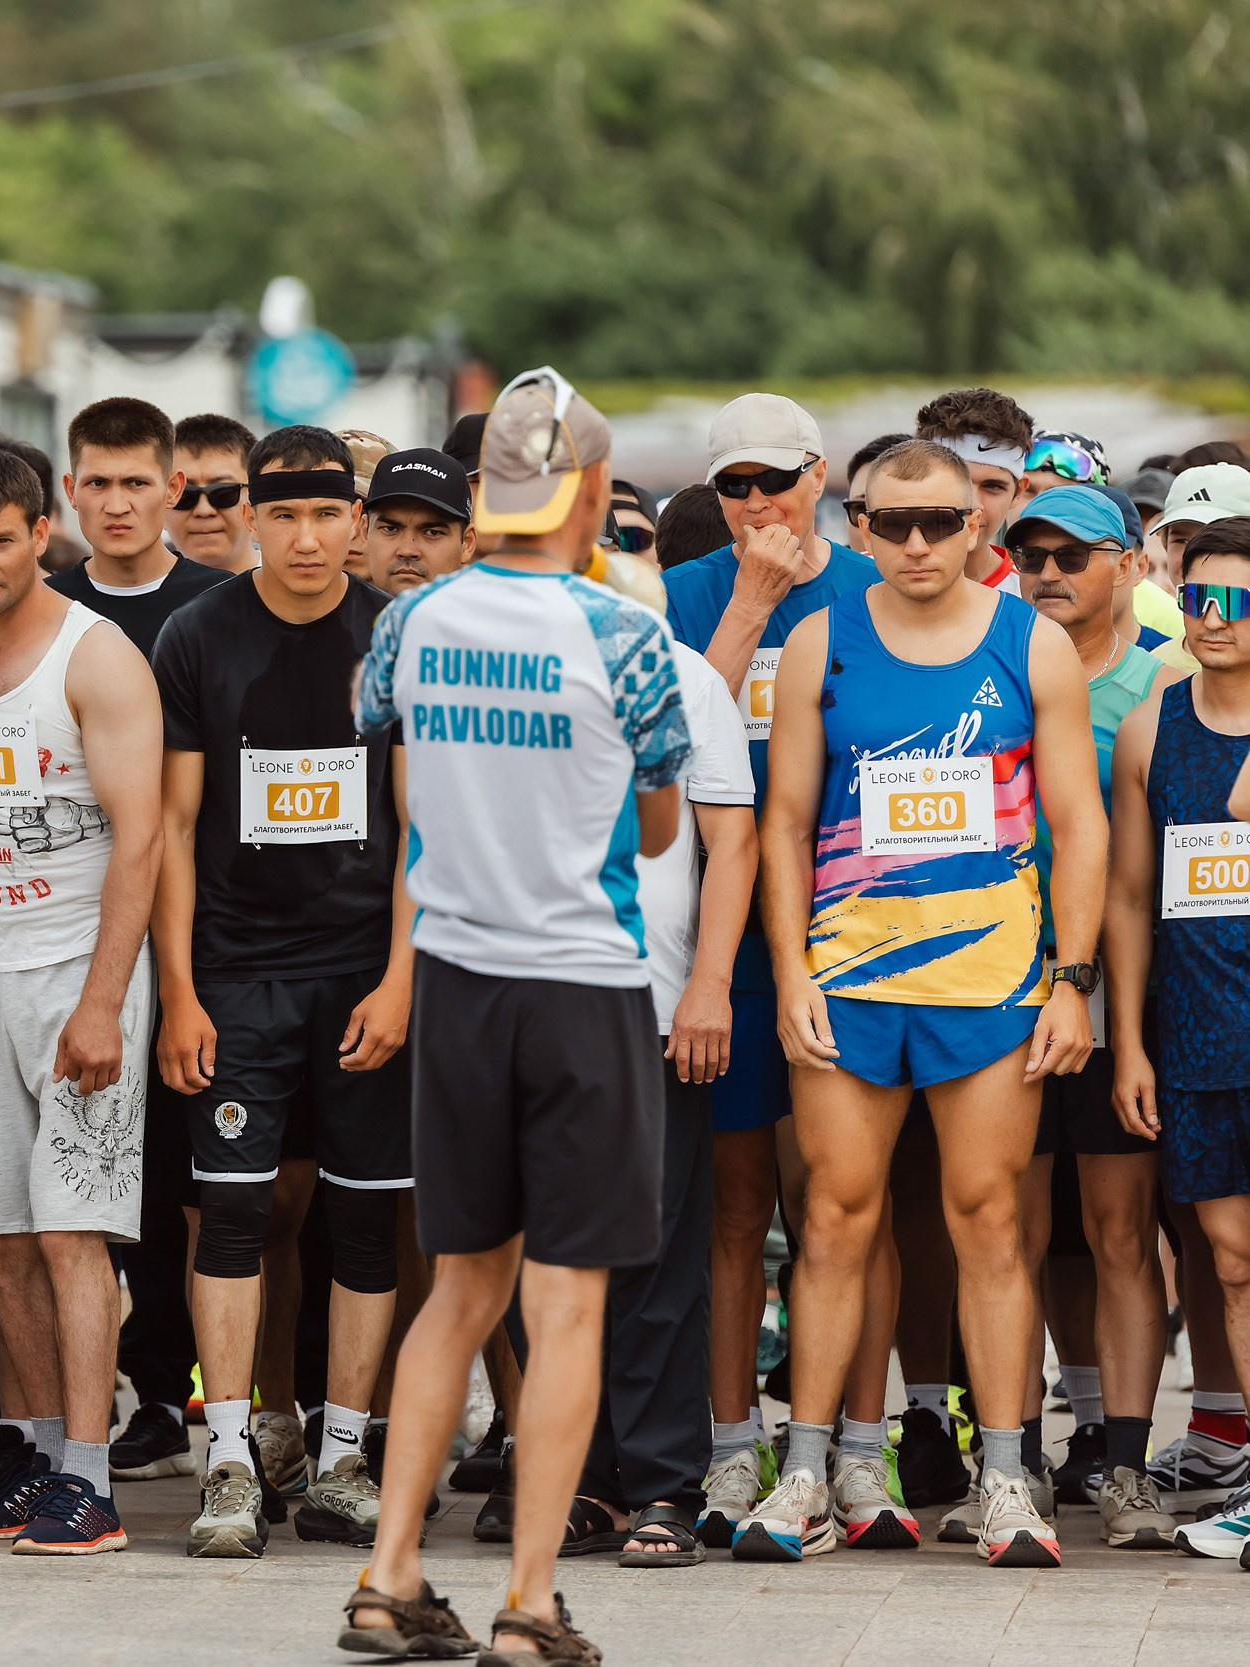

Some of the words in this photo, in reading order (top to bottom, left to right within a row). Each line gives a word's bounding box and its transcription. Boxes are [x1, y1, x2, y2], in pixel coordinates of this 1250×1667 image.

[391, 463, 448, 480] GLASMAN
[419, 646, 562, 693] RUNNING
[750, 660, 778, 671] ONE
[412, 704, 572, 749] PAVLODAR
[252, 762, 294, 773] LEONE
[318, 759, 355, 772] D'ORO
[871, 772, 916, 784] LEONE
[940, 769, 981, 782] D'ORO
[273, 787, 333, 817] 407
[896, 796, 958, 827] 360
[253, 823, 332, 834] БЛАГОТВОРИТЕЛЬНЫЙ
[333, 823, 354, 831] ЗАБЕГ
[875, 834, 959, 845] БЛАГОТВОРИТЕЛЬНЫЙ
[960, 835, 982, 843] ЗАБЕГ
[1174, 836, 1214, 848] LEONE
[1195, 859, 1249, 890] 500
[1174, 896, 1249, 908] БЛАГОТВОРИТЕЛЬНЫЙ
[53, 1155, 97, 1202] FREE
[319, 1492, 358, 1512] CORDURA
